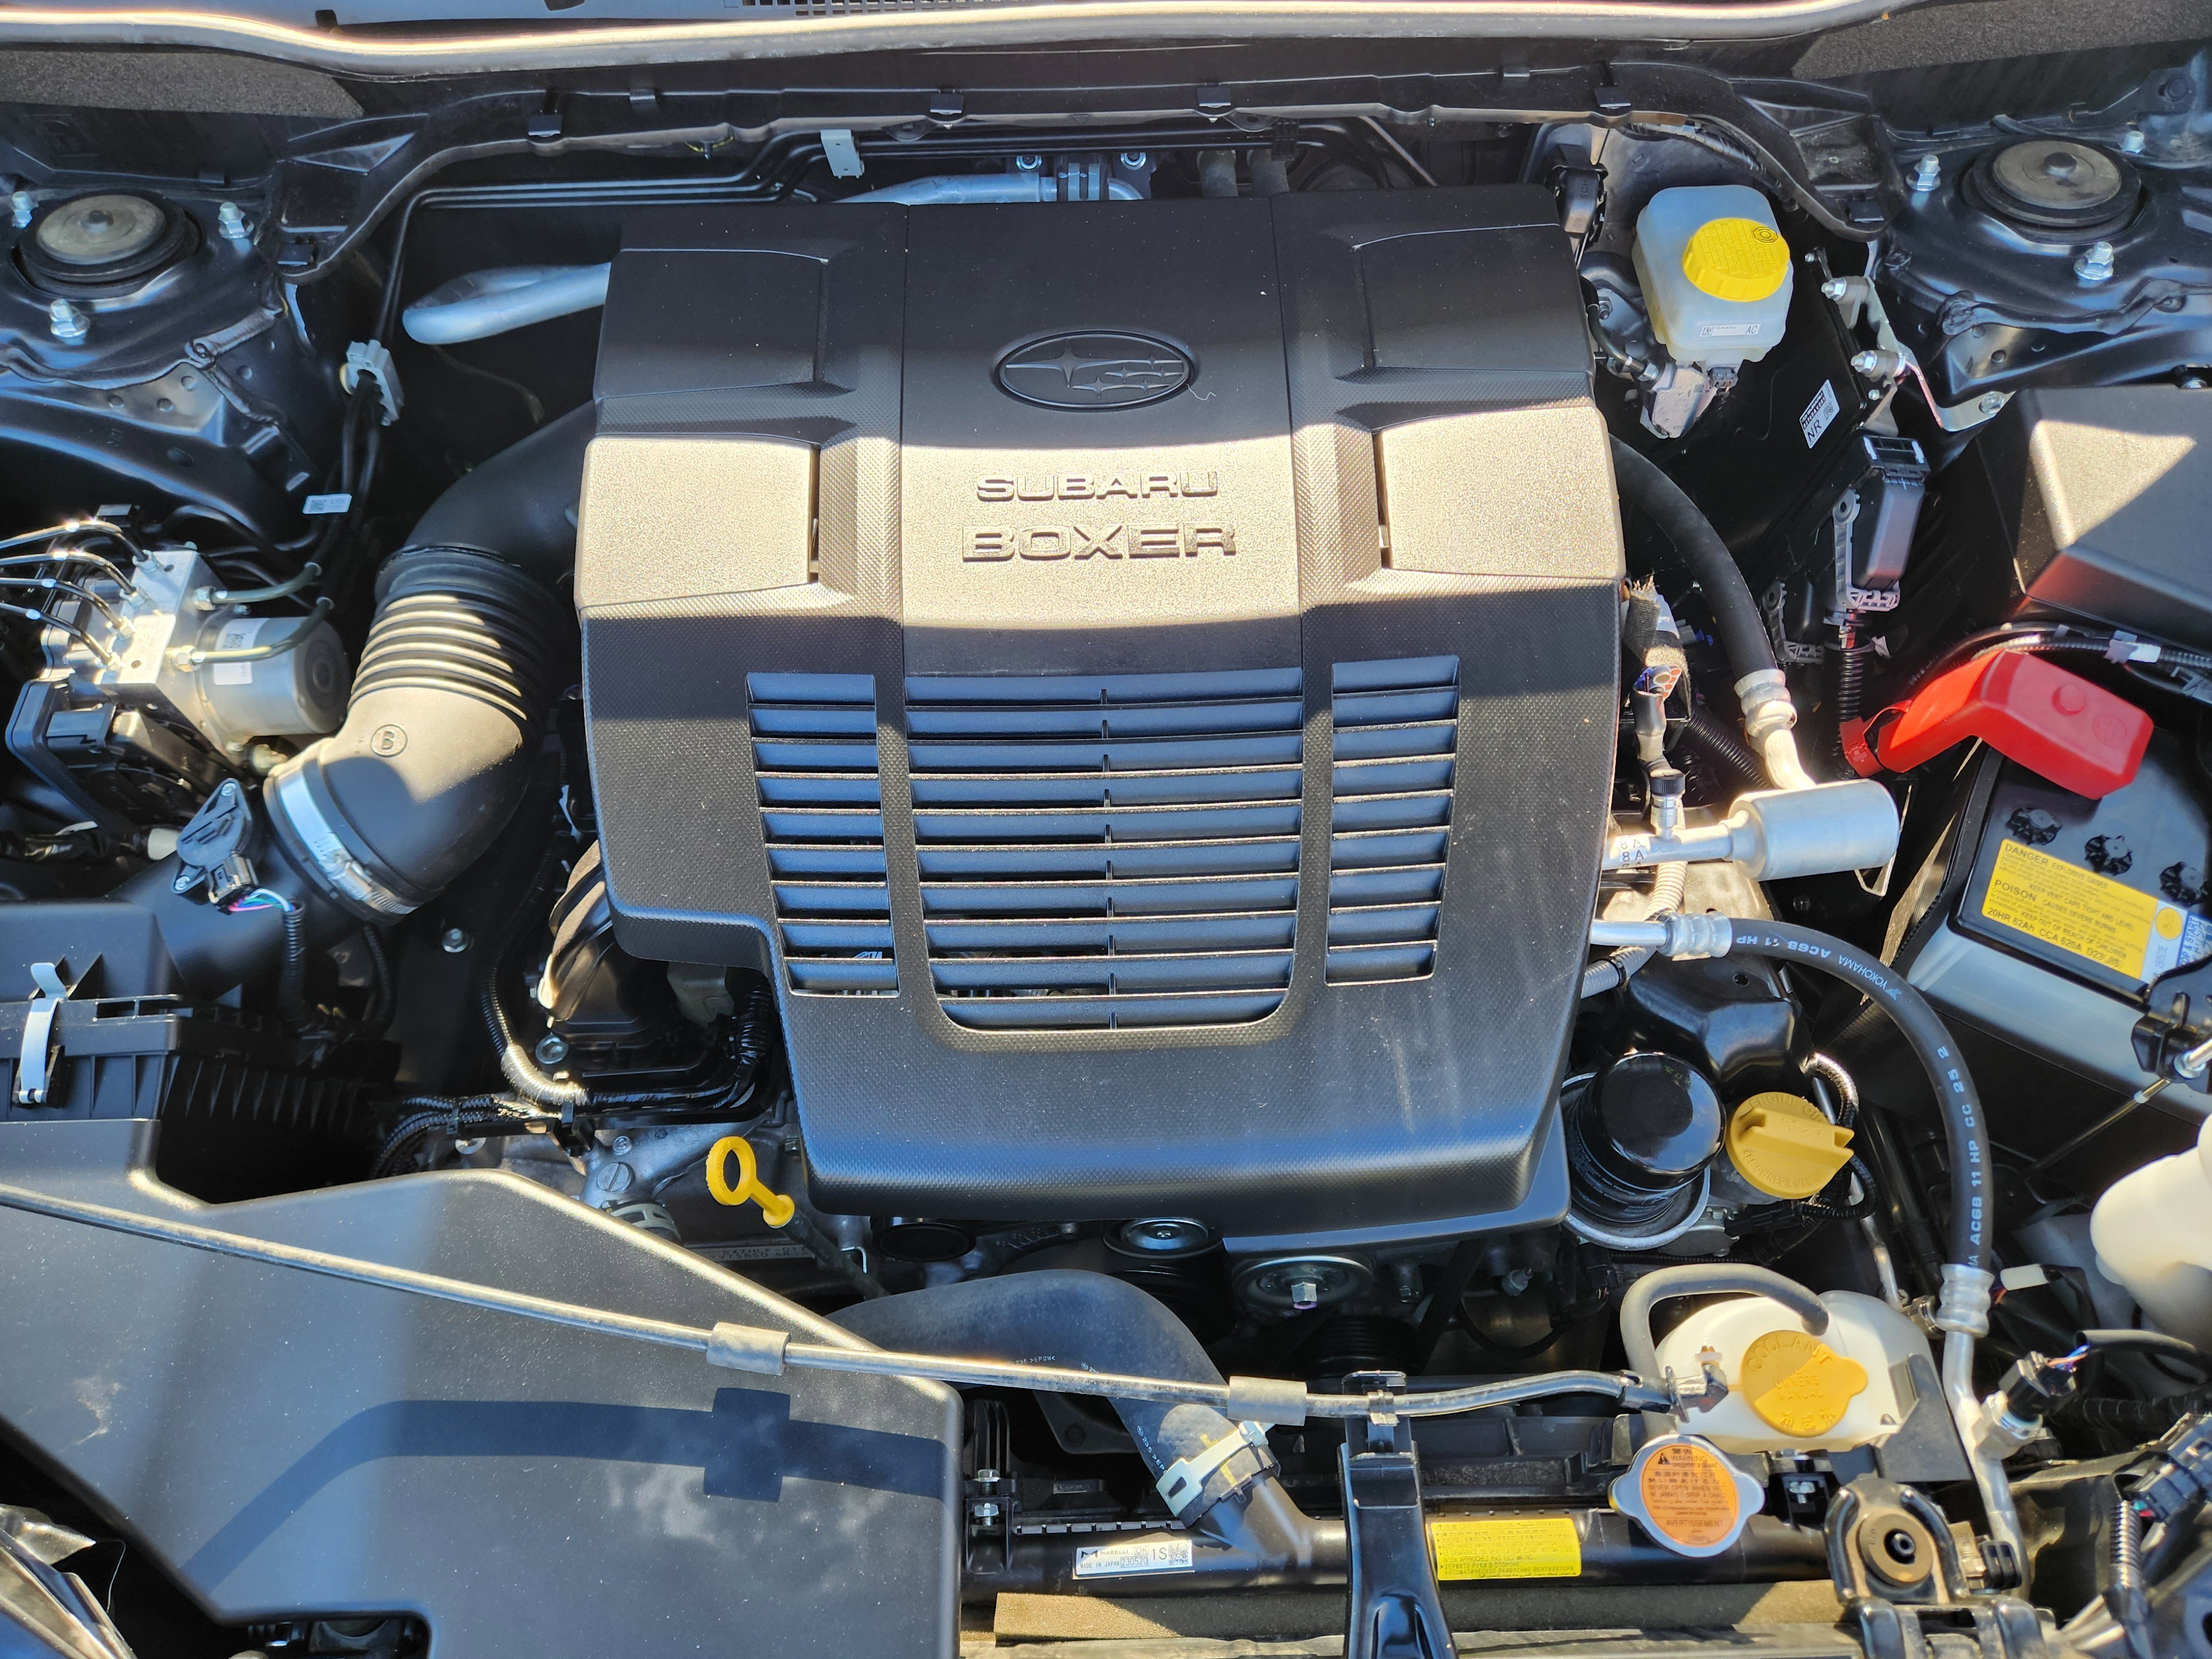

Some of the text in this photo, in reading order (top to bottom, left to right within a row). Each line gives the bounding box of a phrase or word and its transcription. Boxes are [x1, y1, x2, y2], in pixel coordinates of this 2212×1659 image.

[1745, 325, 1757, 335] AC
[1807, 418, 1822, 442] NR
[977, 472, 1217, 501] SUBARU
[963, 522, 1237, 562] BOXER
[1623, 849, 1645, 862] 8 A
[2004, 842, 2050, 867] DANGER
[1993, 878, 2037, 902] POISON
[2028, 883, 2046, 895] KEEP
[1986, 906, 2011, 923] 20HR
[2011, 916, 2036, 933] 62Ah
[2038, 927, 2059, 942] CCA
[2184, 916, 2199, 944] START
[1736, 935, 1758, 945] HP
[1787, 940, 1832, 959] AC6B
[1839, 954, 1888, 990] YOKOHAMA
[1937, 1046, 1950, 1060] 2
[1947, 1068, 1965, 1094] 25
[1749, 1093, 1828, 1124] ENGINE OIL
[1961, 1103, 1976, 1128] CC
[1968, 1140, 1981, 1164] HP
[1970, 1171, 1983, 1187] 11
[1969, 1196, 1983, 1246] AC6B
[1746, 1334, 1833, 1373] COOLANT
[1121, 1557, 1149, 1567] 230520
[1136, 1546, 1147, 1554] OK
